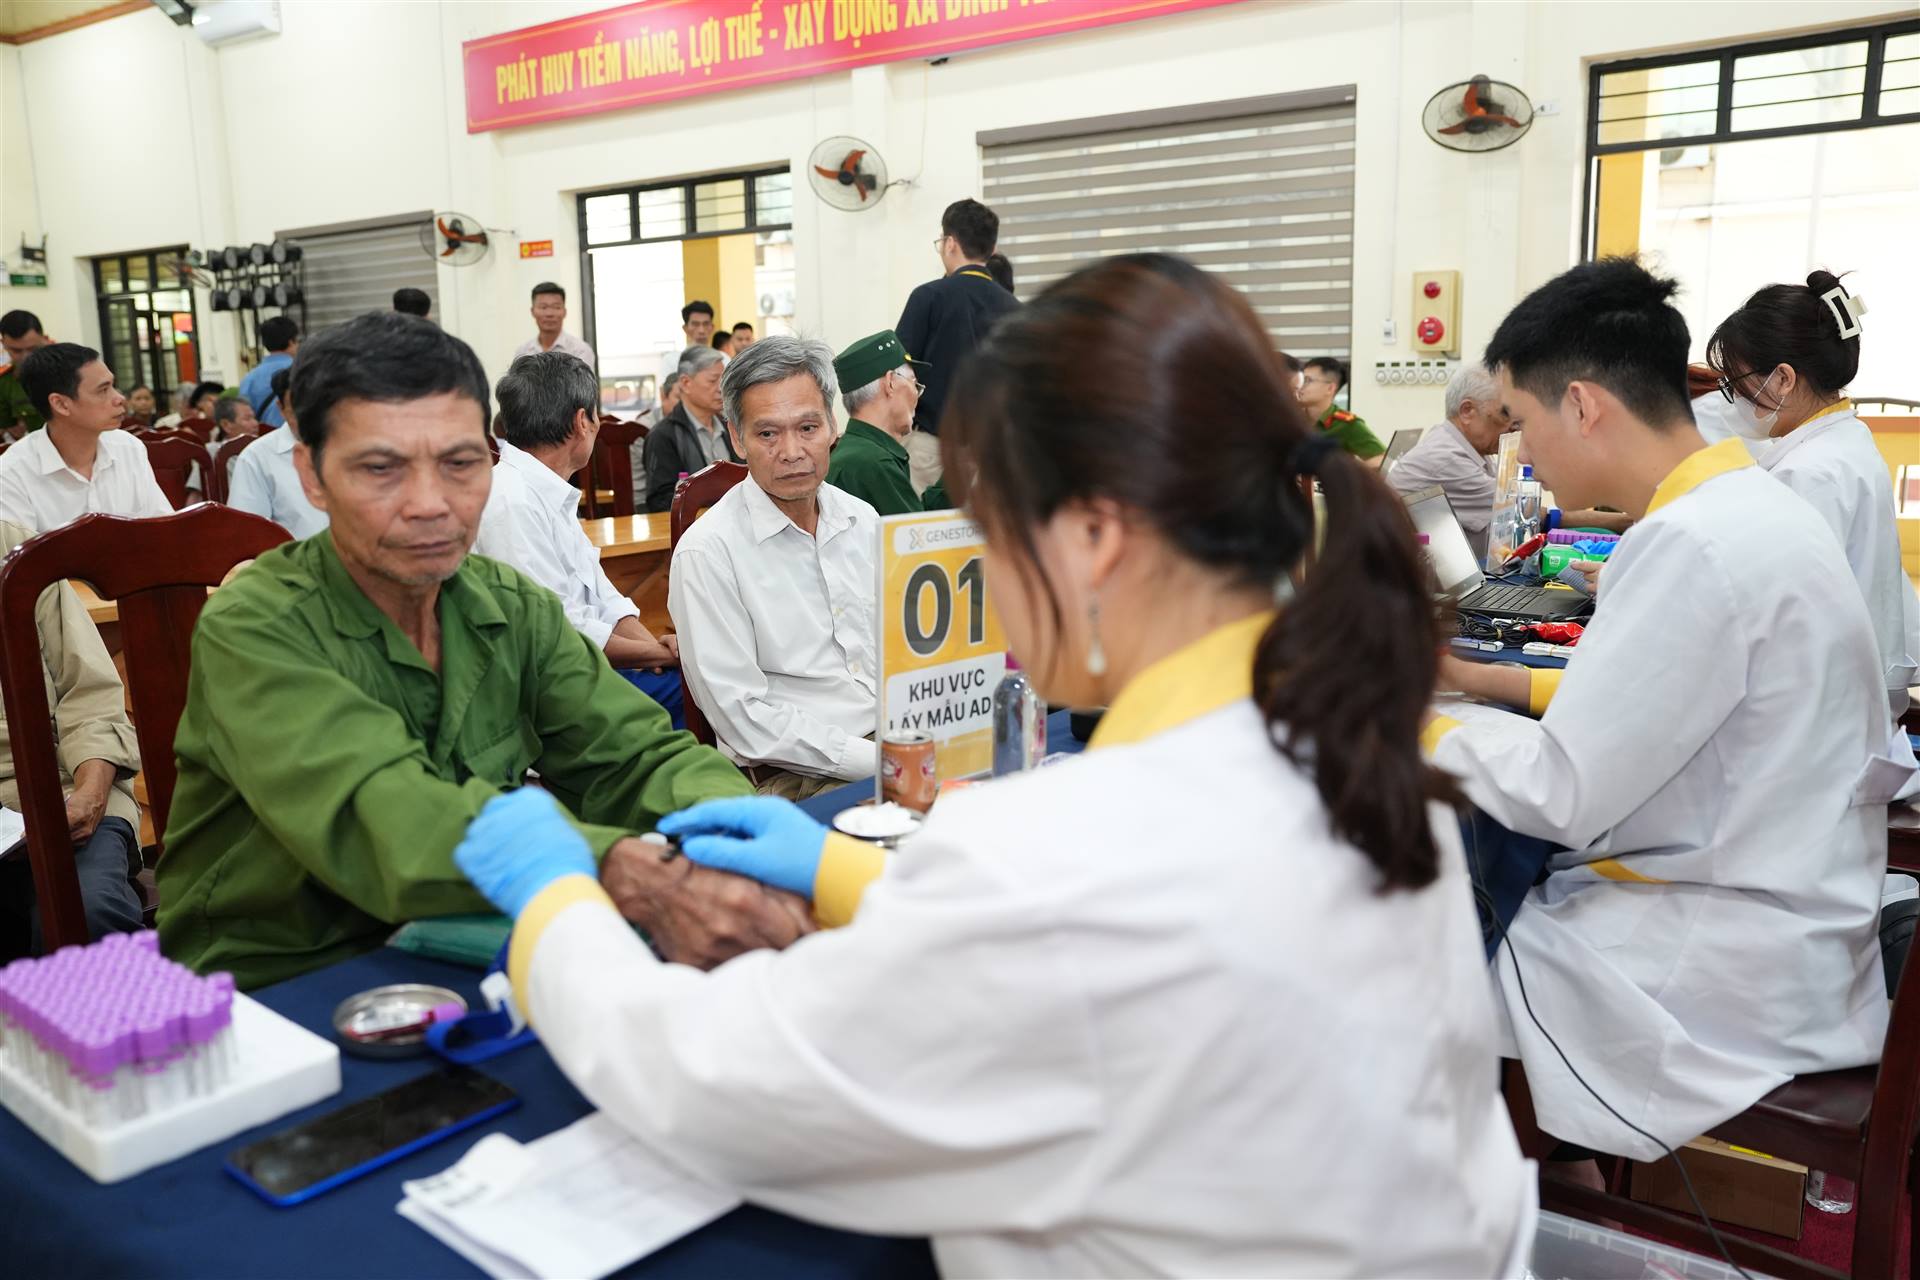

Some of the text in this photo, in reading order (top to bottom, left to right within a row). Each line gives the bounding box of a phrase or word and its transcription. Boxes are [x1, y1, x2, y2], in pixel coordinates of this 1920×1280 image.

[496, 52, 537, 104] PHÁT
[541, 51, 574, 96] HUY
[625, 26, 685, 80] NĂNG,
[689, 16, 721, 76] LỢI
[724, 0, 764, 61] THẾ
[904, 556, 985, 656] 01
[909, 668, 985, 703] KHU VỰC
